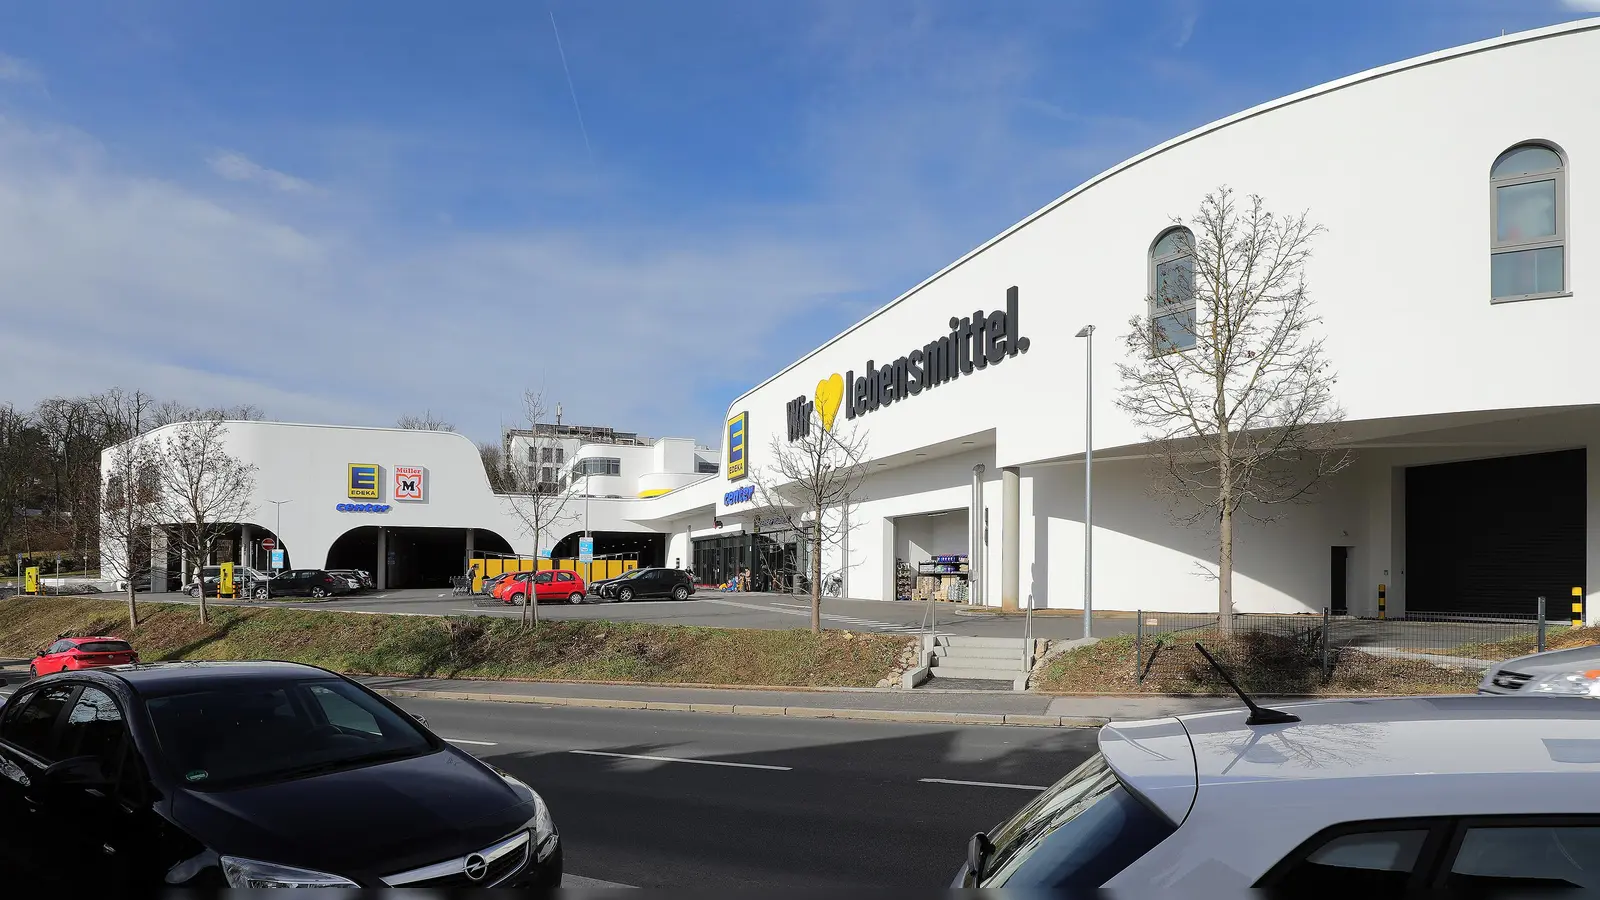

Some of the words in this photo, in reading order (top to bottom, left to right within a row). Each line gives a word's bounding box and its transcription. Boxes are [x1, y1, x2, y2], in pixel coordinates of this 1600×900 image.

[787, 395, 814, 443] Wir
[845, 285, 1031, 421] Lebensmittel.
[730, 419, 743, 464] E
[351, 466, 375, 489] E
[729, 462, 744, 475] EDEKA
[402, 480, 415, 492] M
[724, 485, 756, 507] center
[336, 503, 391, 513] center
